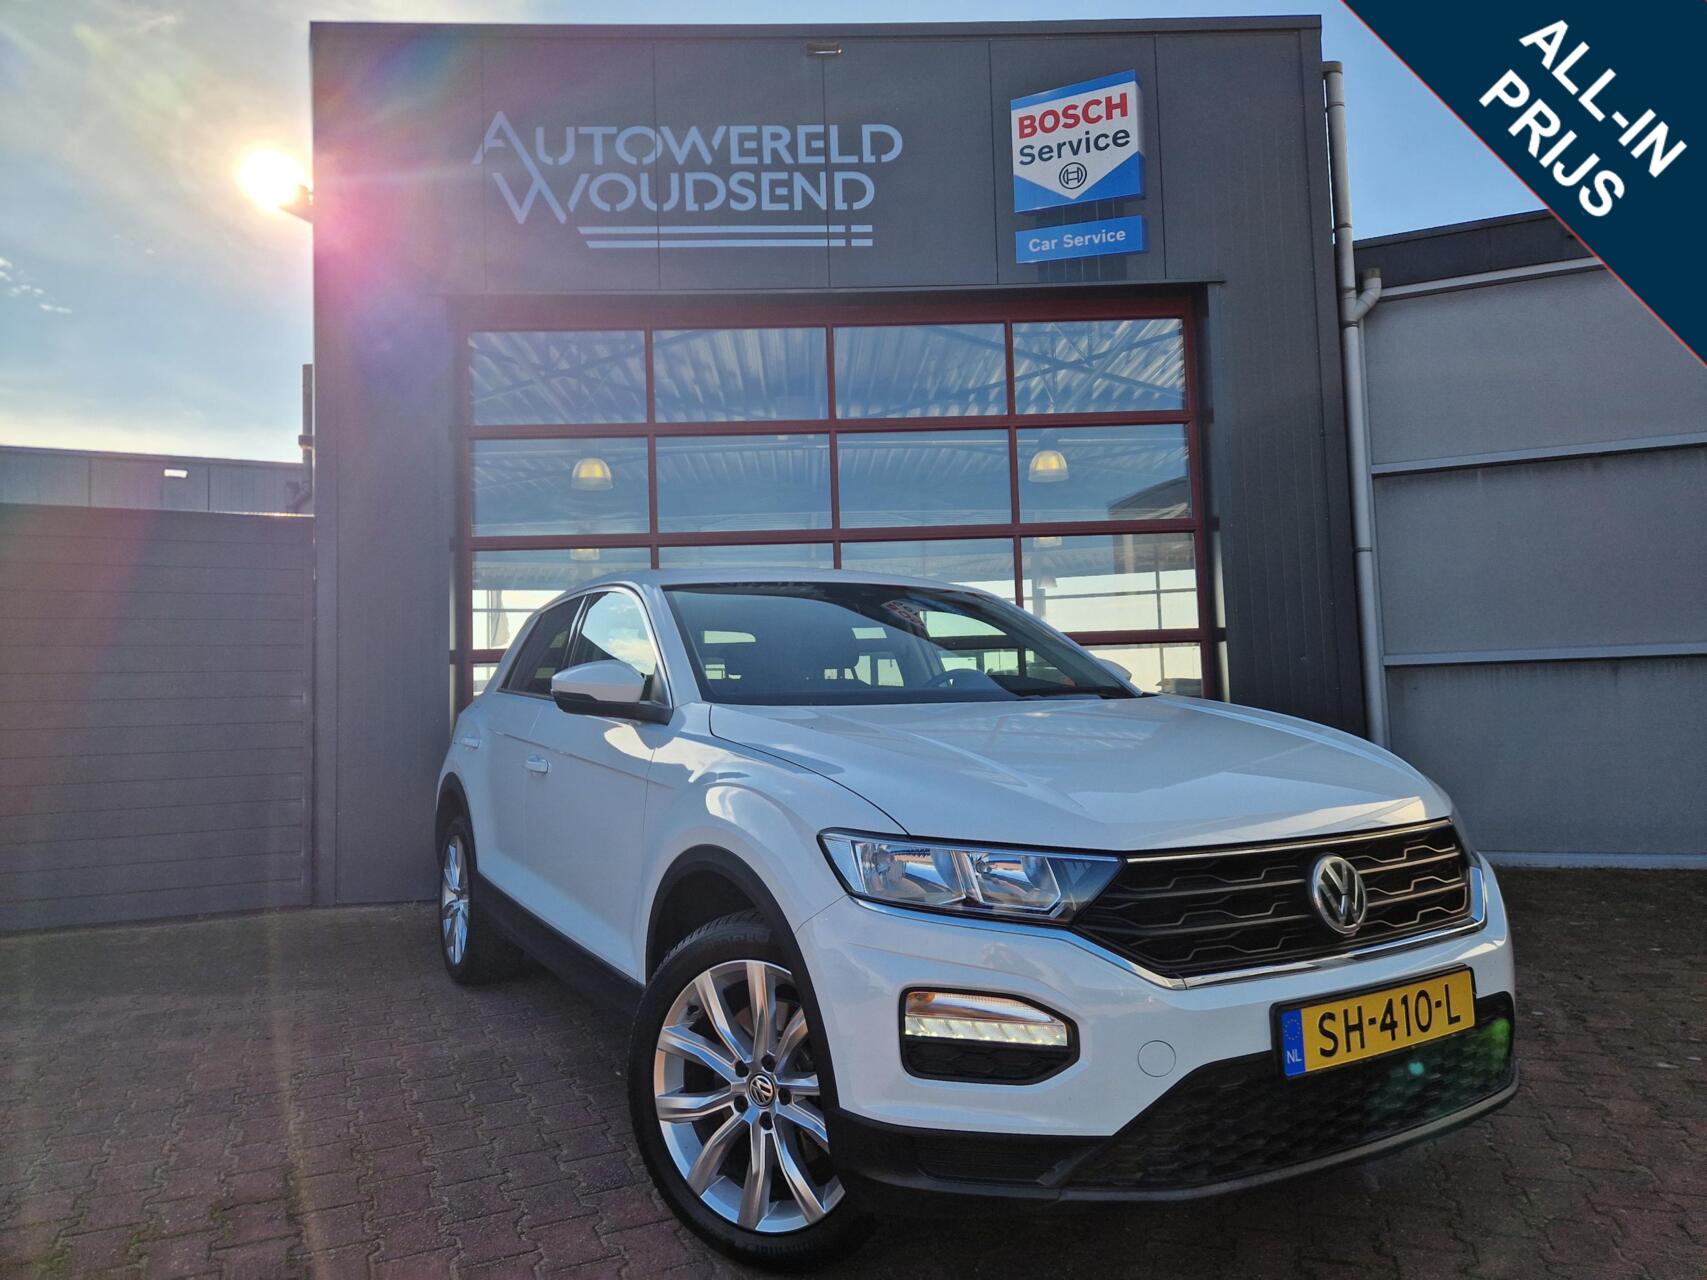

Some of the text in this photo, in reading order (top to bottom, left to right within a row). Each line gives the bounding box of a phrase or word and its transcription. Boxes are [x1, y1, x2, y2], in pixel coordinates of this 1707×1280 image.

[471, 110, 904, 166] AUTOWERELD
[1018, 92, 1129, 139] BOSCH
[1019, 128, 1131, 166] Service
[492, 170, 875, 225] WOUDSEND
[1028, 229, 1127, 253] Car Service
[1317, 983, 1462, 1058] SH-410-L
[1286, 1049, 1303, 1064] NL
